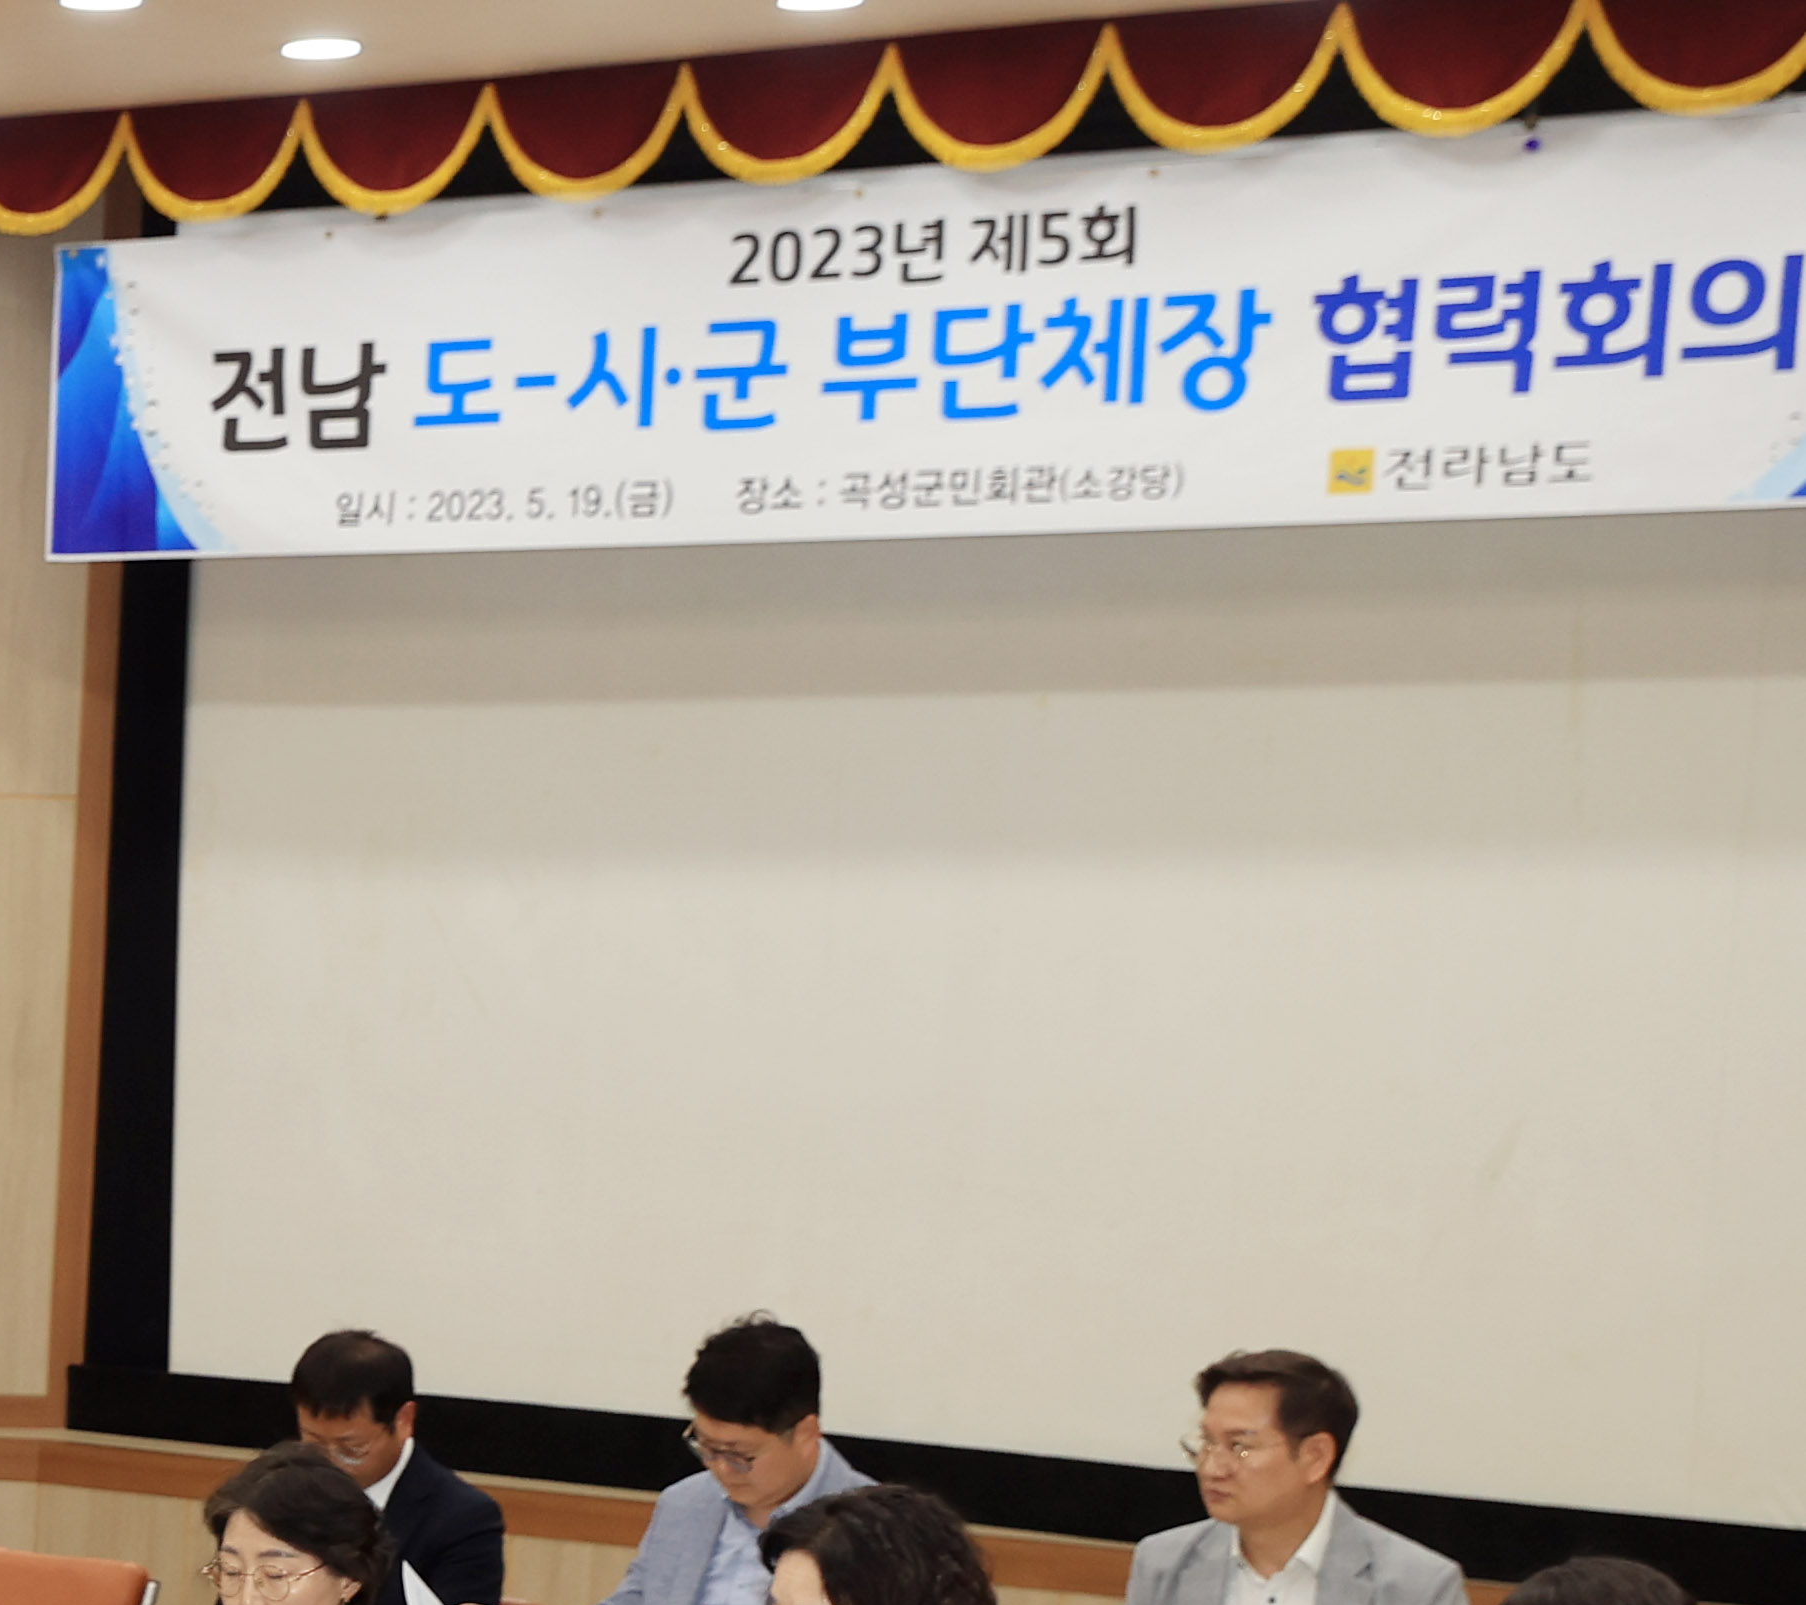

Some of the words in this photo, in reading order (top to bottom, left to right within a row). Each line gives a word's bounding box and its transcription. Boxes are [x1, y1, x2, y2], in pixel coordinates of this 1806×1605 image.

[729, 217, 946, 285] 2023년
[970, 203, 1138, 272] 제5회
[211, 342, 386, 452] 전남
[821, 288, 1272, 421] 부단체장
[1313, 254, 1806, 402] 협력회의
[736, 475, 802, 515] 장소
[839, 460, 1185, 511] 곡성군민회관(소강당)
[1383, 441, 1593, 491] 전라남도
[336, 490, 396, 528] 일시
[426, 489, 514, 523] 2023.
[528, 486, 555, 520] 5.
[569, 479, 674, 520] 19.(금)
